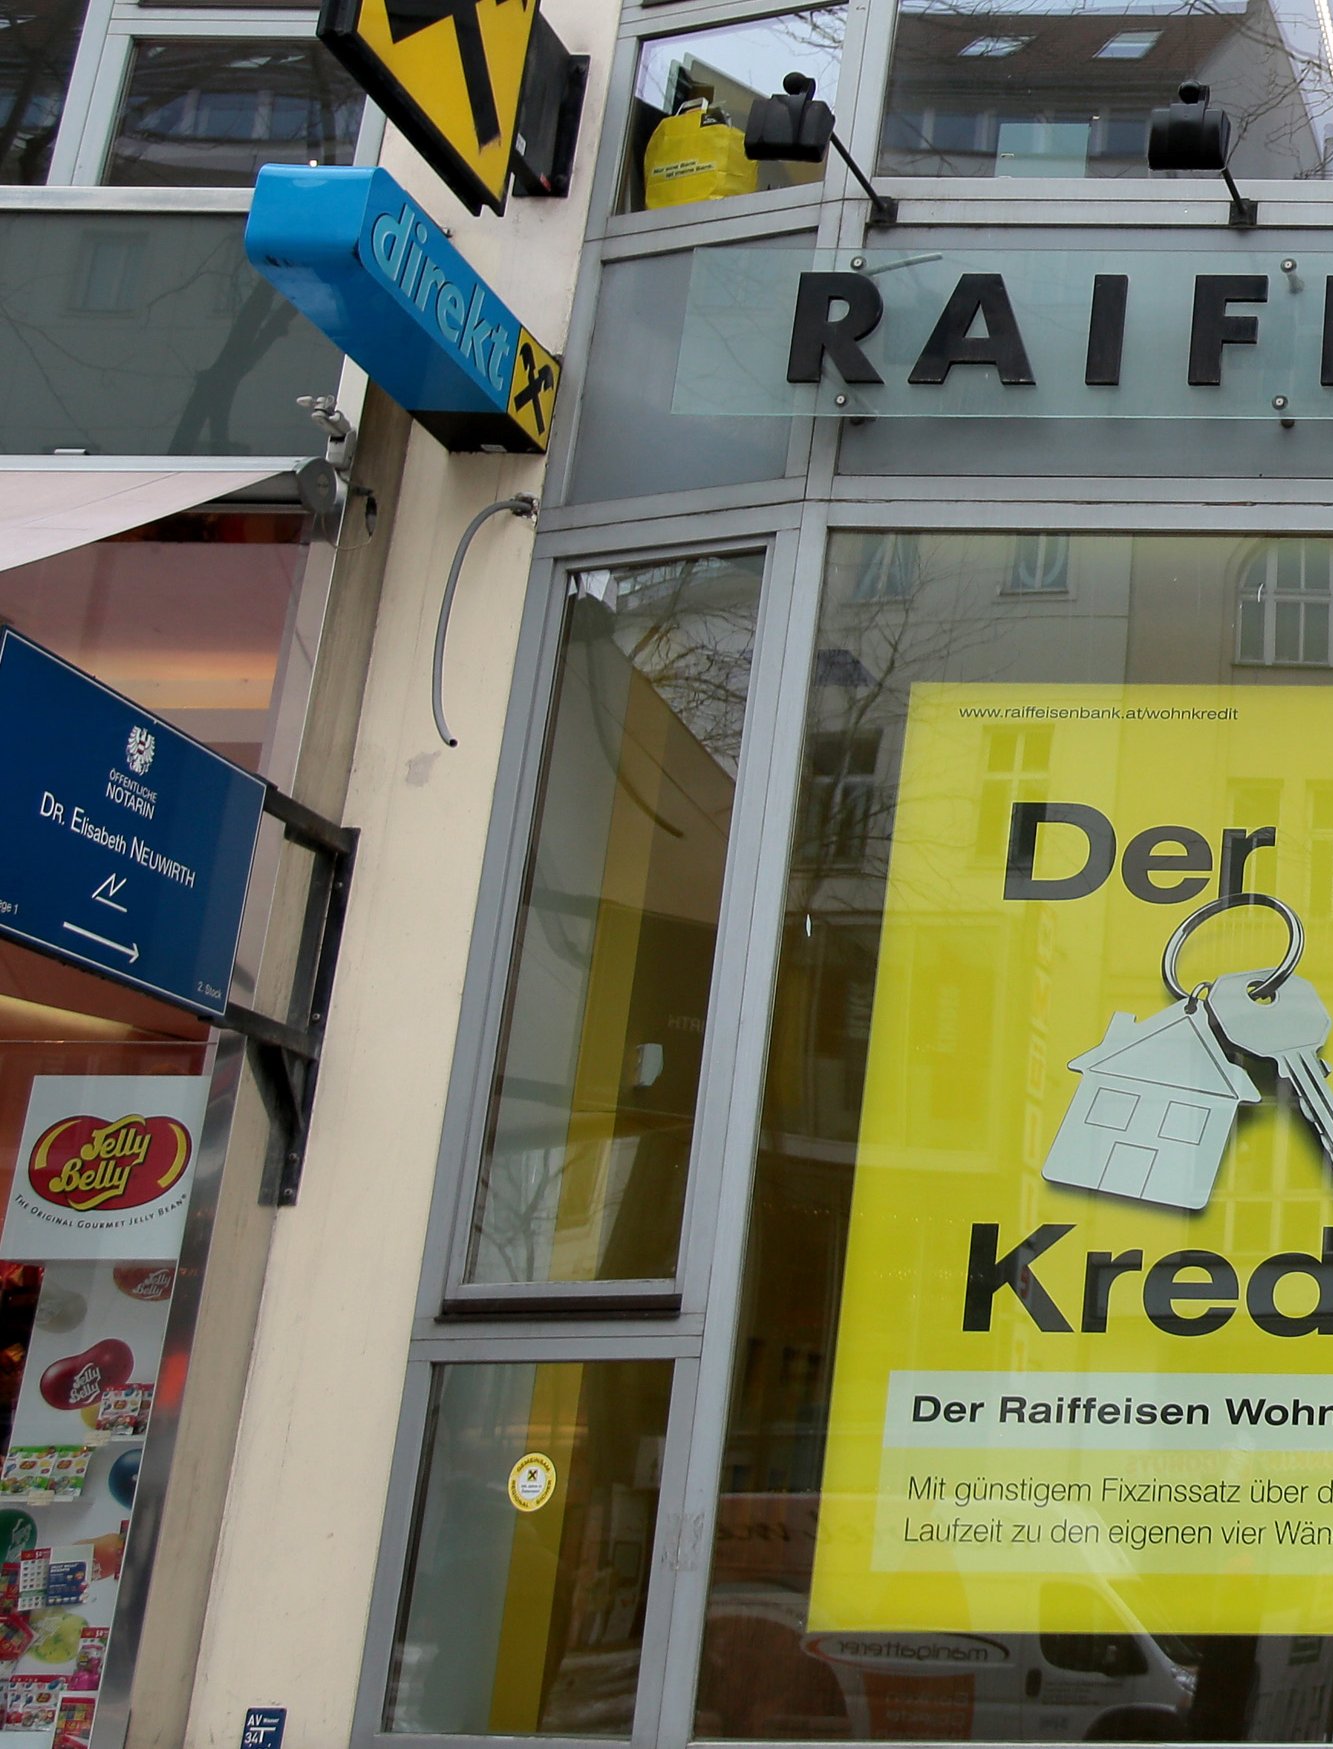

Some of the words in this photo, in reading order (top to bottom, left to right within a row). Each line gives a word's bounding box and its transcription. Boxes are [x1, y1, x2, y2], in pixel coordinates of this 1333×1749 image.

[372, 203, 511, 392] direkt
[958, 706, 1239, 721] www.raiffeisenbank.at/wohnkredit
[105, 782, 155, 820] NOTARIN
[109, 768, 158, 803] ÖFFENTLICHE
[71, 806, 127, 855] Elisabeth
[1003, 801, 1276, 905] Der
[81, 1114, 152, 1165] Jelly
[48, 1158, 132, 1212] Belly
[132, 1282, 163, 1299] Belly
[144, 1269, 172, 1288] Jelly
[73, 1362, 101, 1388] Jelly
[69, 1380, 100, 1404] Belly
[912, 1395, 985, 1423] Der
[999, 1396, 1210, 1425] Raiffeisen
[907, 1475, 947, 1501] Mit
[954, 1476, 1092, 1508] günstigem
[1101, 1477, 1241, 1503] Fixzinssatz
[1250, 1479, 1309, 1504] über
[904, 1517, 1004, 1543] Laufzeit
[1010, 1523, 1042, 1543] zu
[1051, 1519, 1100, 1544] den
[1107, 1519, 1212, 1551] eigenen
[1220, 1520, 1267, 1545] vier
[247, 1713, 263, 1727] AV
